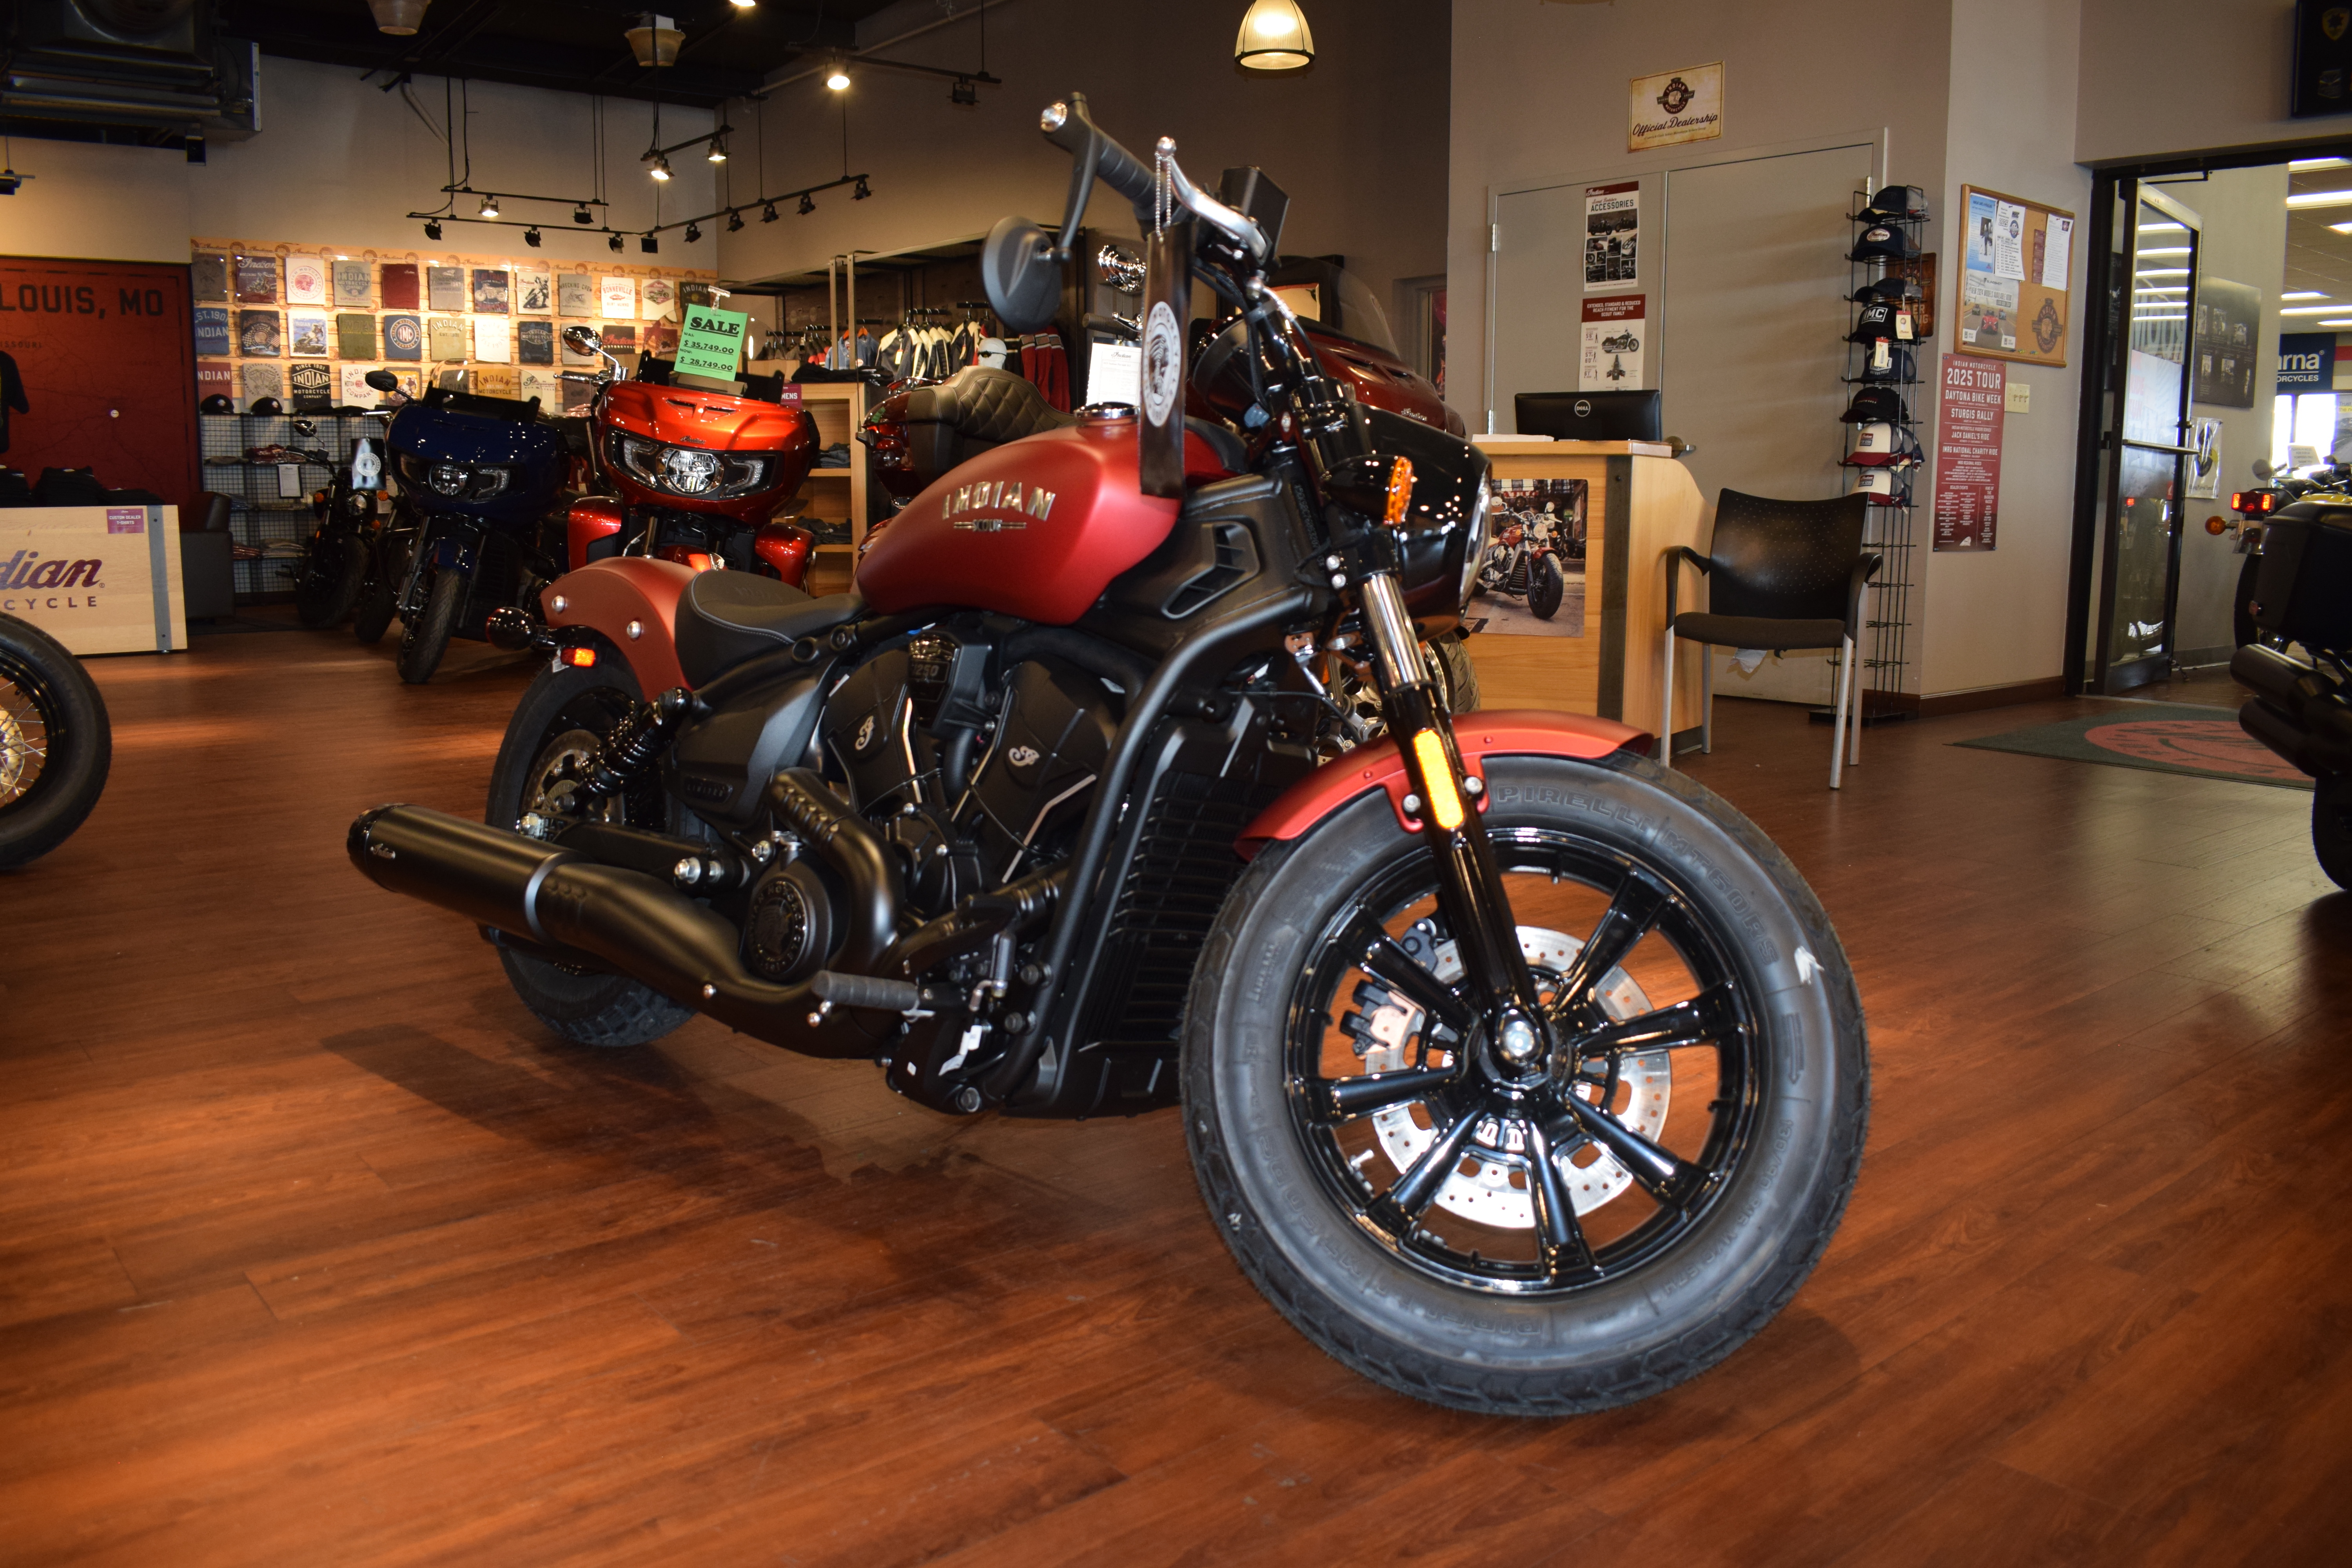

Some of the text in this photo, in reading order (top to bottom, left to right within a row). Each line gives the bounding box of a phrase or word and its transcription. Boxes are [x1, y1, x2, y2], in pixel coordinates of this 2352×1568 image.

[1666, 82, 1686, 93] INDIAN
[1632, 113, 1718, 137] Official Dealership
[1591, 199, 1634, 212] ACCESSORIES
[338, 272, 371, 281] INDIAN
[602, 285, 633, 295] BONNEVILLE
[683, 284, 708, 294] INDIAN
[0, 283, 164, 319] LOUIS, MO
[1864, 308, 1885, 319] IMC
[432, 319, 465, 331] INDIAN
[690, 317, 740, 335] SALE
[398, 326, 413, 341] IMC
[691, 341, 734, 354] 35,749.00
[690, 358, 733, 371] 28,749.00
[1969, 362, 1996, 371] MOTORCYCLE
[198, 371, 230, 380] NDIAN
[294, 369, 329, 387] INDIAN
[346, 368, 368, 379] INDIA
[479, 374, 511, 386] INDIAN
[1947, 367, 2001, 389] 2025 TOUR
[346, 388, 374, 399] COMPANY
[1945, 390, 1970, 401] DAYTONA
[1972, 392, 1985, 403] BIKE
[1986, 394, 2001, 404] WEEK
[1951, 408, 1994, 421] STURGIS RALLY
[942, 481, 1056, 521] INDIAN
[4, 596, 97, 611] CYCLE
[1495, 783, 1656, 834] PIRELLI
